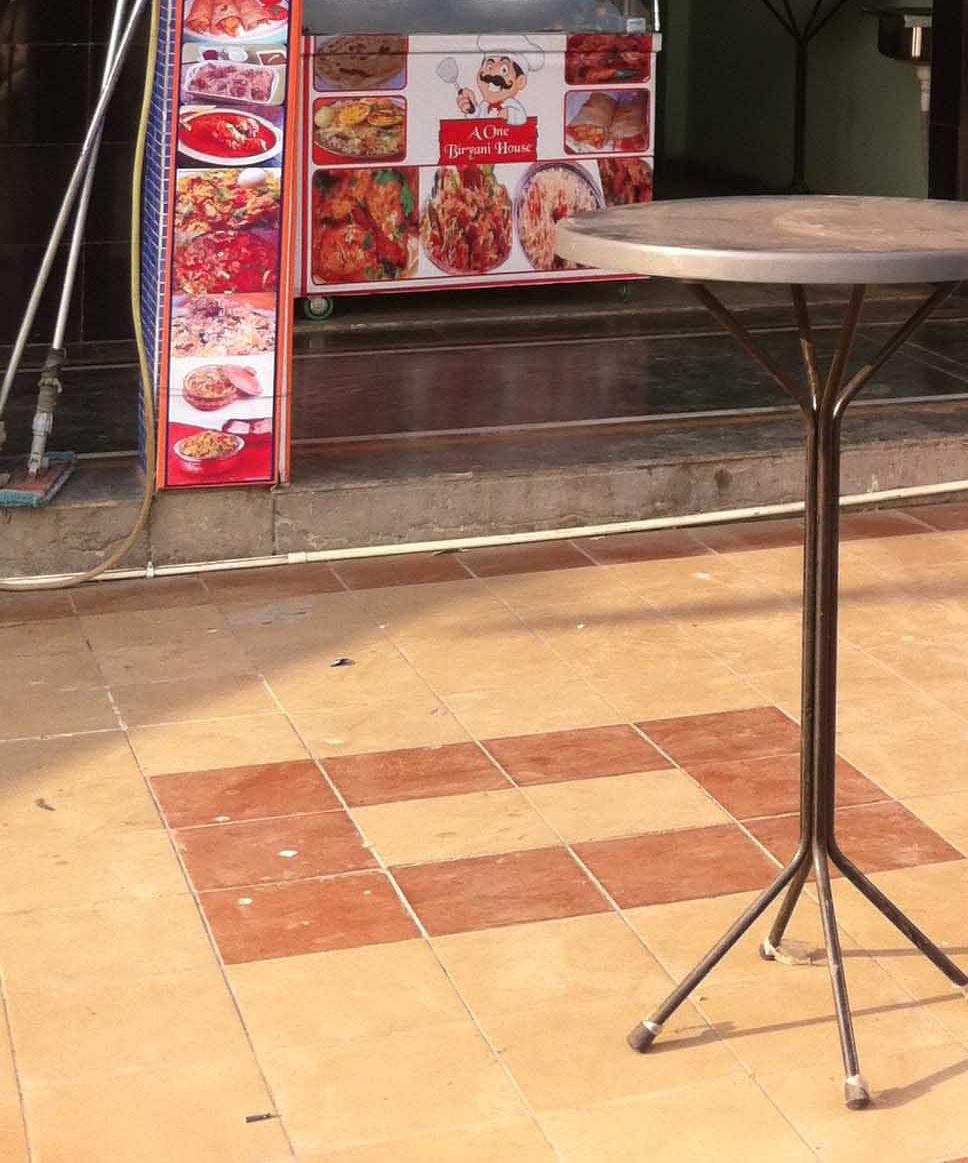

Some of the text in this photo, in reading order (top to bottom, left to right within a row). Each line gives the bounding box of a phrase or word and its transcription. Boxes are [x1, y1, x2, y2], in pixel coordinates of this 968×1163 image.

[467, 123, 510, 141] A One
[443, 140, 532, 161] Biryani House
